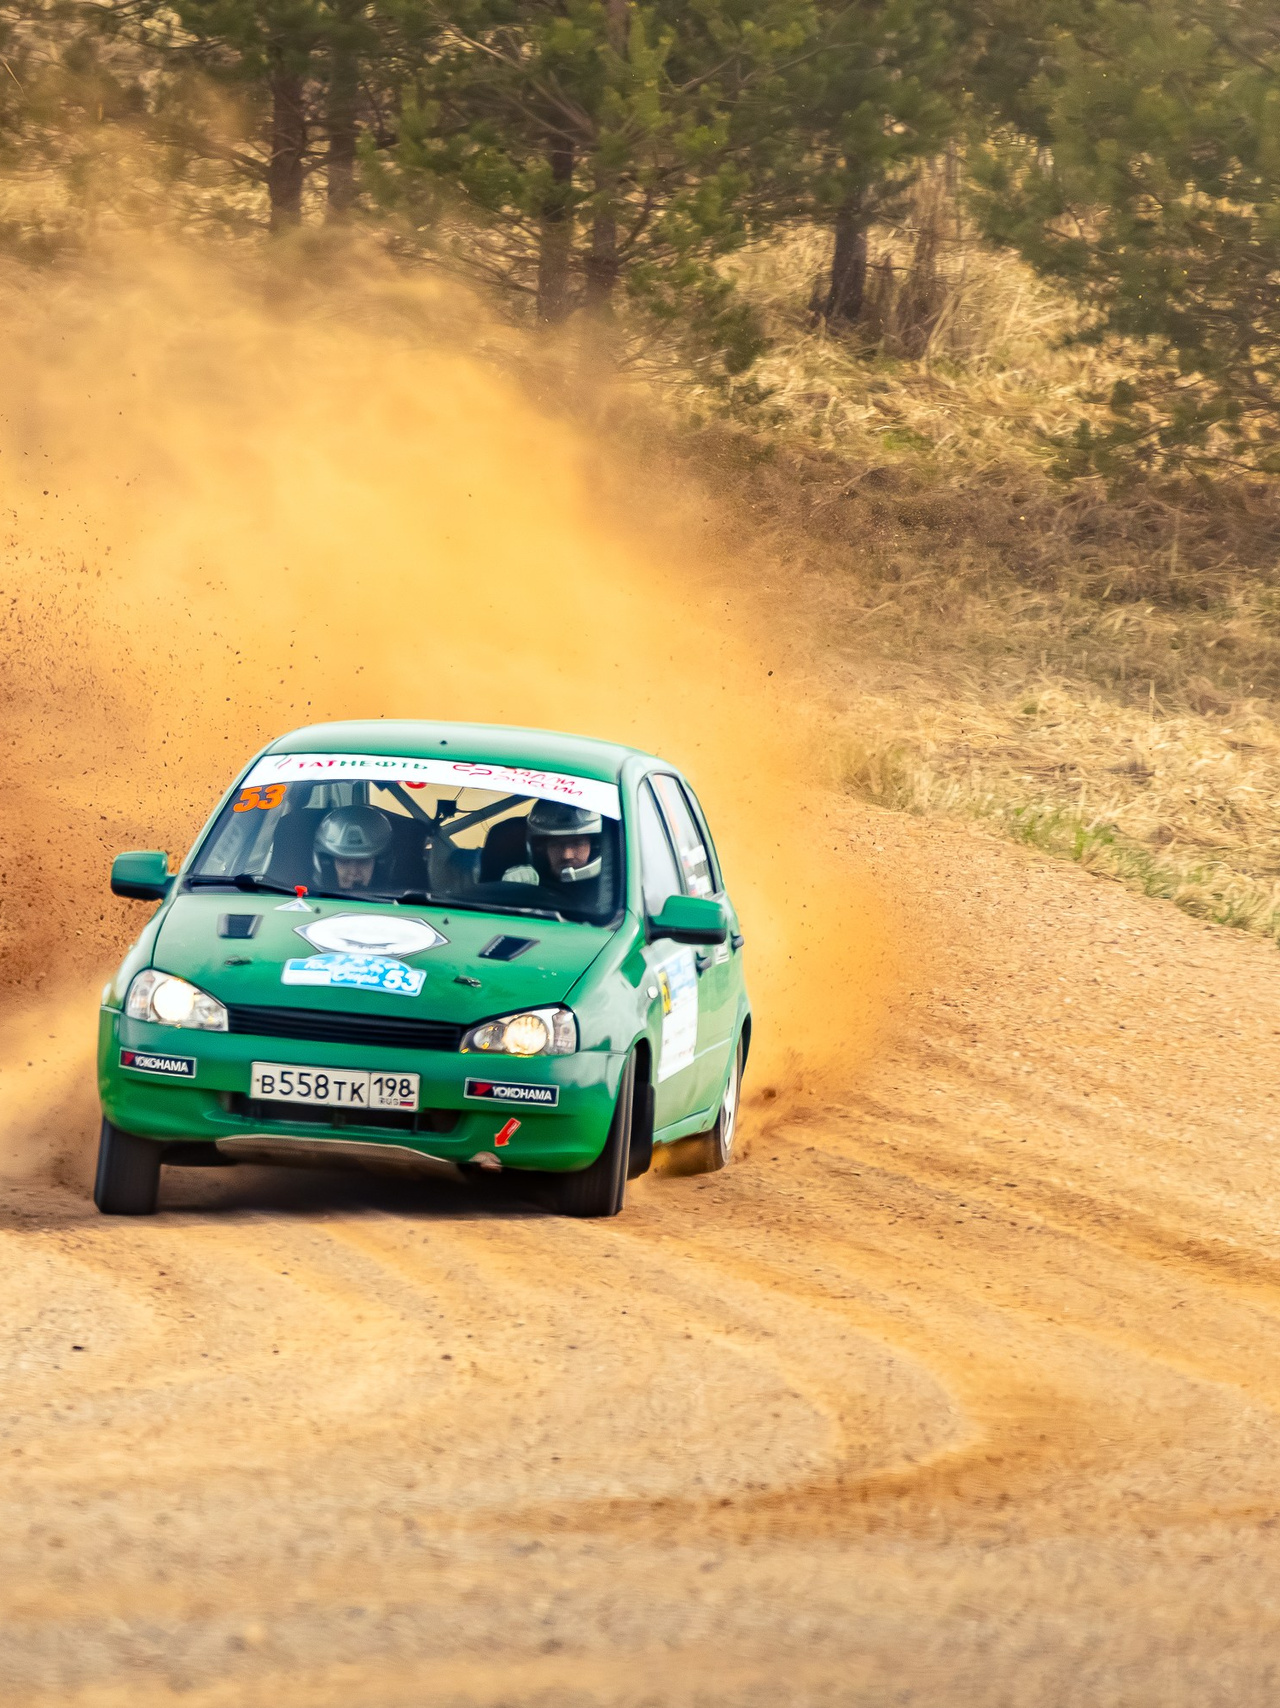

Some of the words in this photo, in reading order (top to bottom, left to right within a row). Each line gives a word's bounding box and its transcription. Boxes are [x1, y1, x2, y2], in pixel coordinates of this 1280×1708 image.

[233, 783, 287, 813] 53
[382, 968, 421, 992] 53
[134, 1055, 189, 1073] YOKOHAMA
[373, 1077, 411, 1098] 198
[492, 1086, 552, 1101] YOKOHAMA
[379, 1097, 400, 1106] RUS
